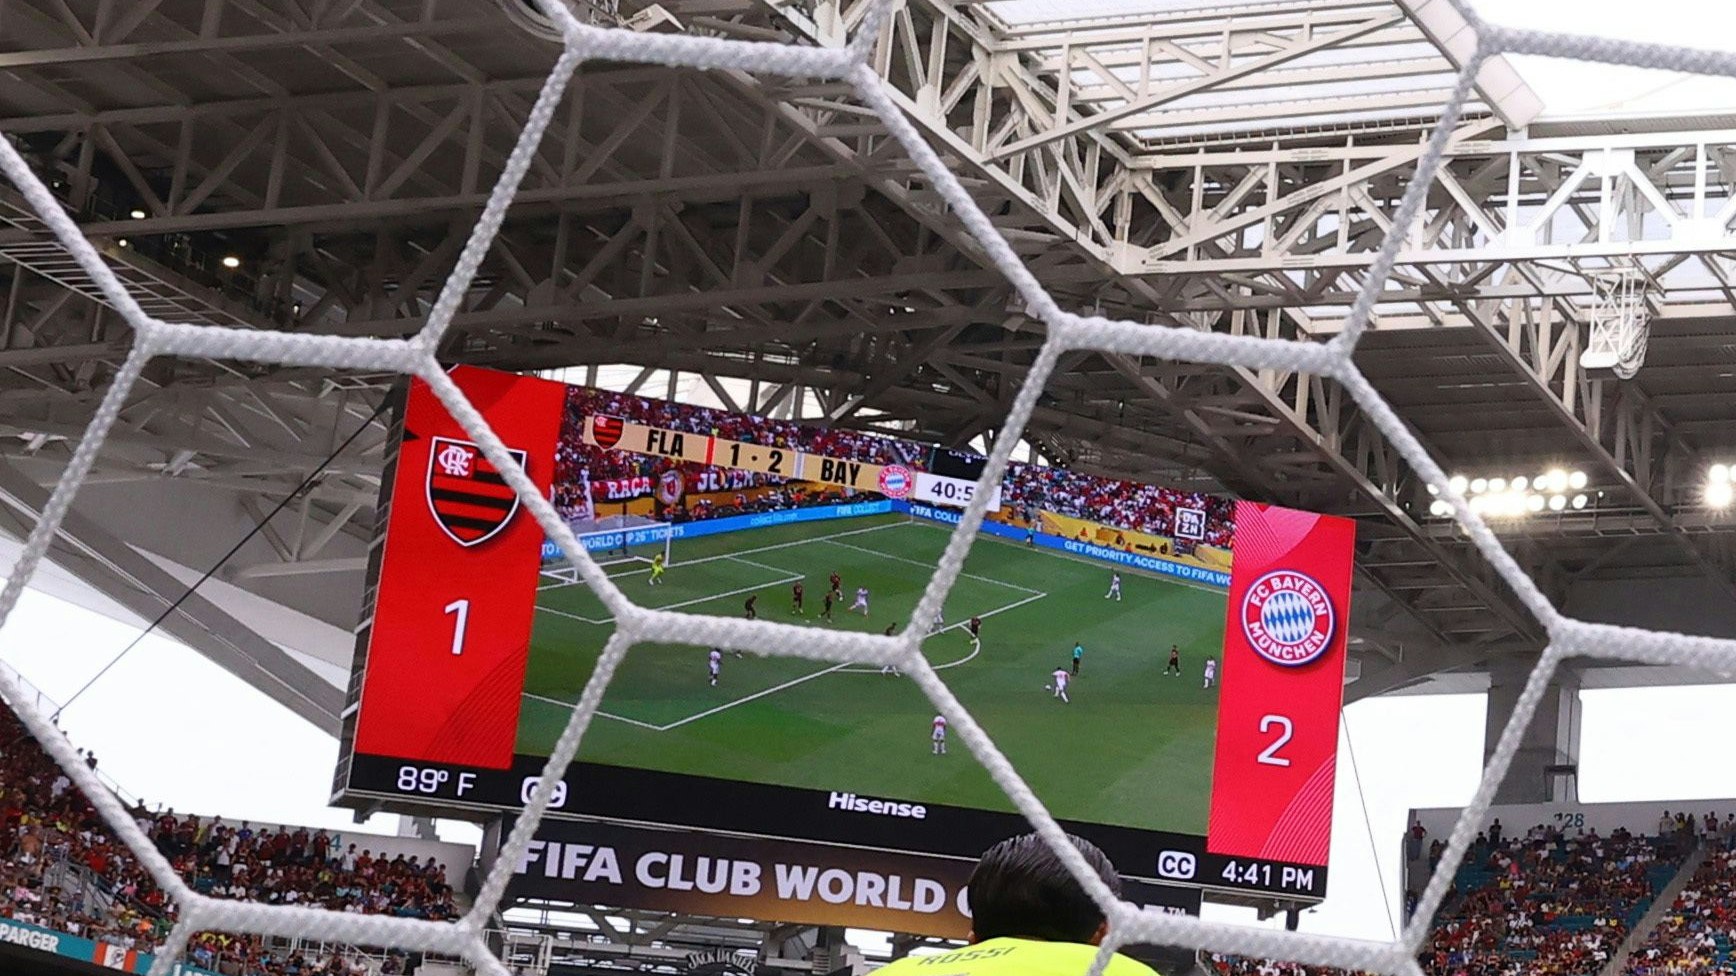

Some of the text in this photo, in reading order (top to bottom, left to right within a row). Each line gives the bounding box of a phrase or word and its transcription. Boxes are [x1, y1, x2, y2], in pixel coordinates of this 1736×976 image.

[646, 429, 860, 486] FLA 1 2 BAY
[931, 483, 975, 501] 40:5
[1064, 540, 1215, 580] GET PRIORITY ACCESS TO FIFA
[1250, 576, 1328, 616] FC BAYERN
[443, 599, 470, 656] 1
[1249, 621, 1325, 659] MÜNCHEN
[1257, 714, 1293, 767] 2
[829, 792, 926, 819] Hisense
[512, 841, 622, 884] FIFA
[635, 853, 760, 895] CLUB
[775, 863, 945, 914] WORLD
[1222, 866, 1313, 890] 4:41 PM
[918, 946, 1017, 966] ROSSI
